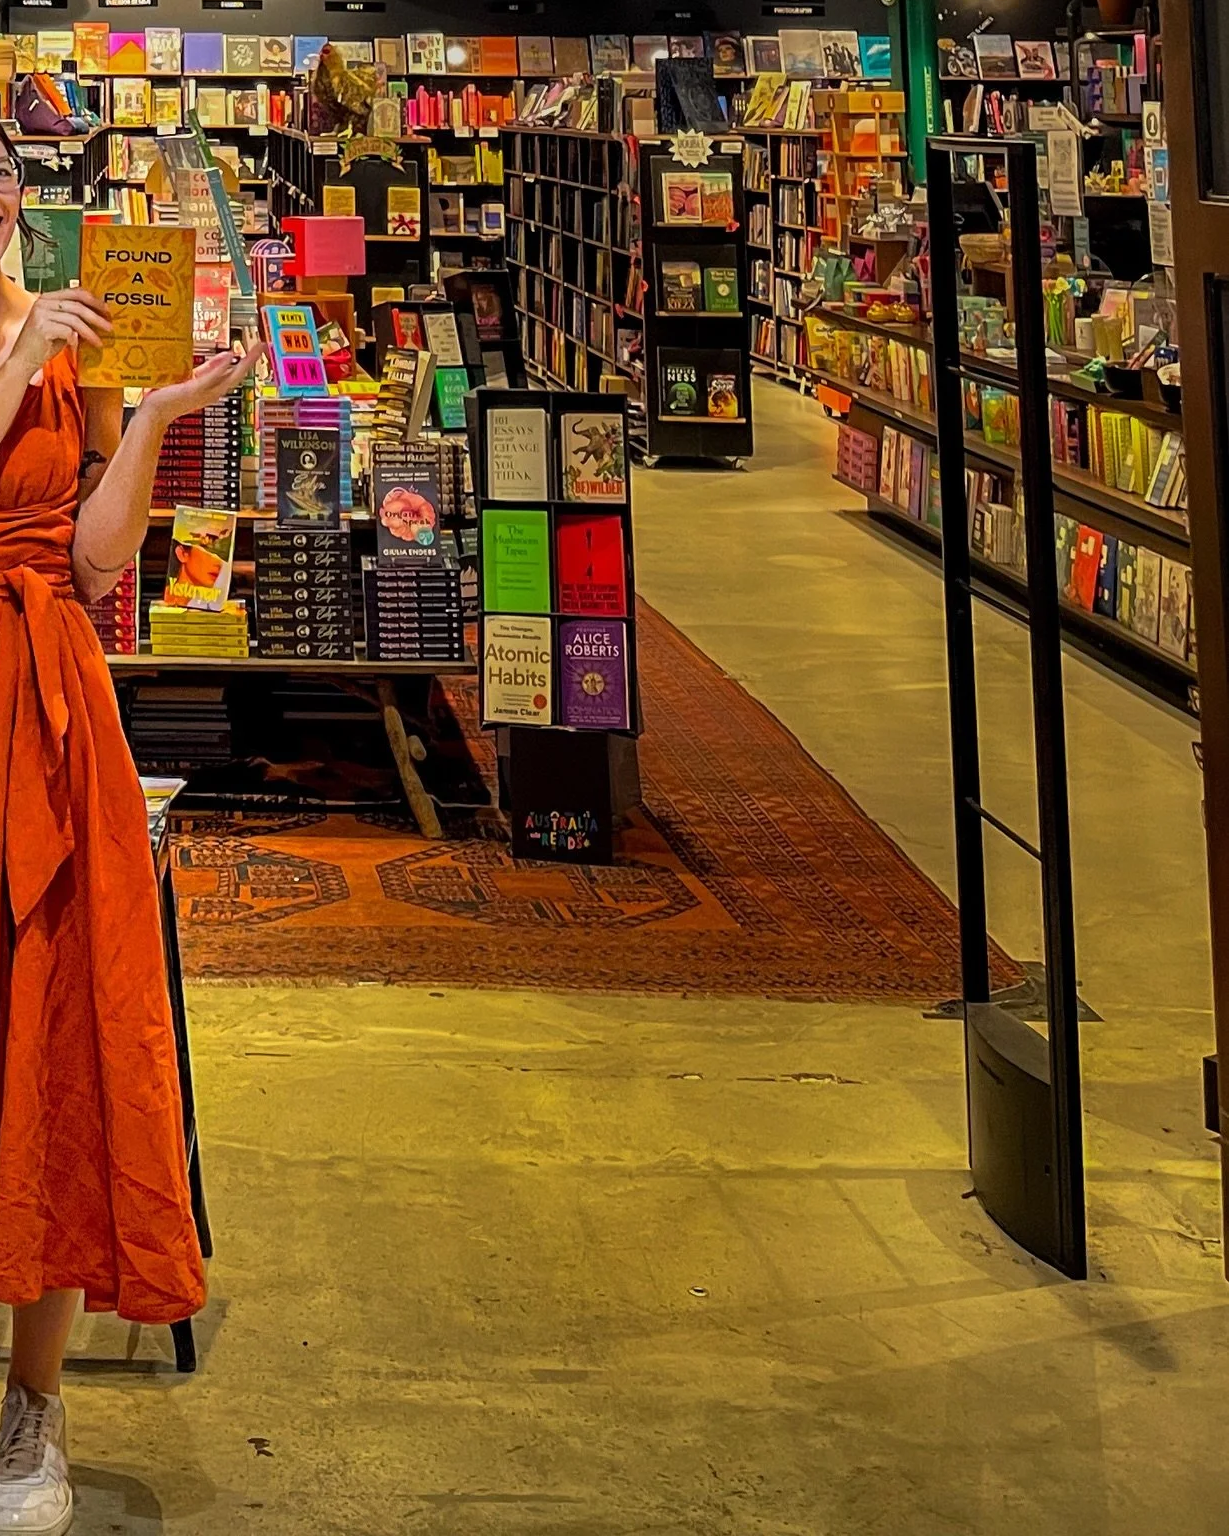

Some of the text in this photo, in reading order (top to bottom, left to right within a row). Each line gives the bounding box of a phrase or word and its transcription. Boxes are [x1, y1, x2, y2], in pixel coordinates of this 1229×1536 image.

[105, 250, 172, 264] FOUND
[131, 272, 144, 284] A
[104, 293, 171, 306] FOSSIL
[193, 311, 222, 321] ASONS
[284, 335, 309, 348] WHO
[289, 367, 318, 380] WIN
[667, 374, 696, 382] NESS
[495, 416, 508, 424] 101
[299, 432, 318, 440] LISA
[494, 426, 533, 435] ESSAYS
[281, 440, 335, 450] WILKINSON
[495, 444, 539, 452] CHANGE
[495, 461, 514, 469] YOU
[495, 471, 531, 480] THINK
[507, 525, 524, 535] The
[169, 577, 221, 604] Yesteryear
[573, 633, 610, 644] ALICE
[485, 644, 550, 664] Atomic
[565, 645, 620, 657] ROBERTS
[489, 667, 547, 688] Habits
[494, 707, 540, 717] James Clear
[525, 811, 598, 831] AUSTRALIA
[541, 833, 584, 850] READS
